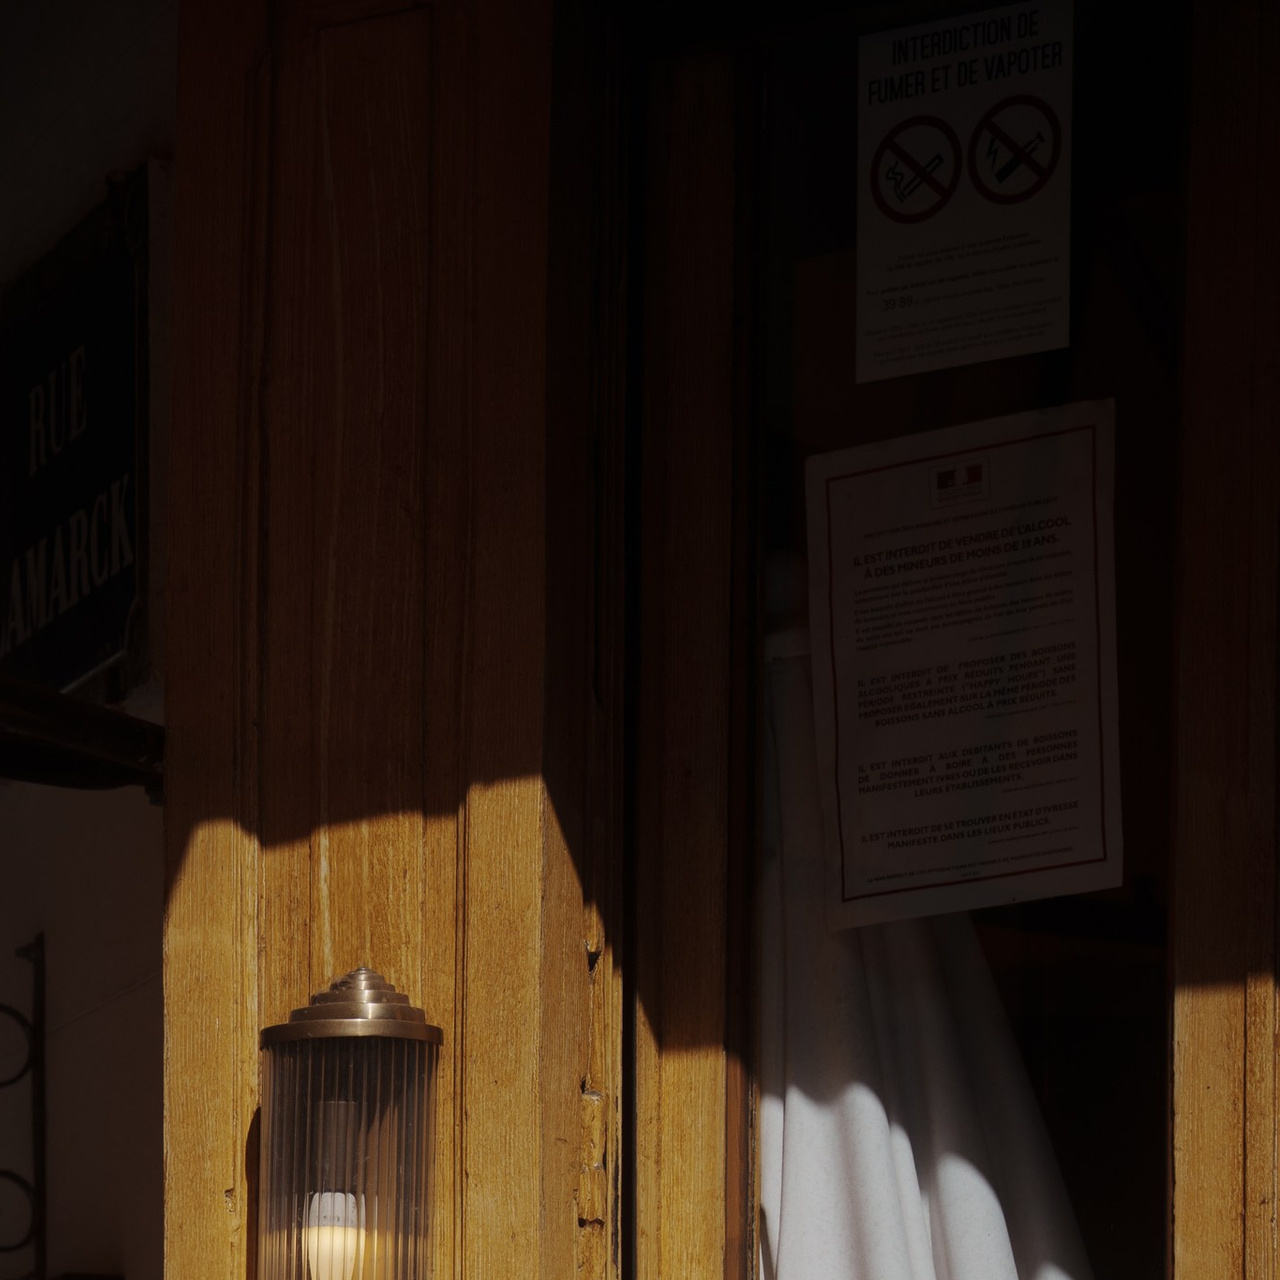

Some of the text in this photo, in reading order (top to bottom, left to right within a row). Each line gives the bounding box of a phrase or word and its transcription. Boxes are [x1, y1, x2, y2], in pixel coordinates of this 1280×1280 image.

[892, 9, 1038, 66] INTERDICTION DE
[868, 40, 1062, 106] FUMER ET DE VAPOTER
[882, 297, 895, 311] 39
[899, 294, 913, 308] 89
[28, 344, 88, 479] RUE
[853, 556, 862, 566] IL
[864, 552, 884, 564] EST
[885, 541, 936, 560] INTERDIT
[938, 538, 952, 550] DE
[955, 529, 998, 547] VENDRE
[1000, 526, 1014, 538] DE
[1017, 515, 1071, 534] L'ALCOOL
[864, 567, 872, 579] À
[874, 564, 895, 577] DES
[897, 554, 947, 573] MINEURS
[949, 551, 963, 563] DE
[966, 544, 1002, 560] MOINS
[1004, 541, 1018, 552] DE
[1022, 538, 1031, 549] 18
[1032, 533, 1059, 547] ANS.
[858, 750, 1078, 795] MANIFESTEMENT IVRES OU DE LES RECEVOIR DANS
[914, 785, 943, 797] LEURS
[861, 834, 867, 843] IL
[869, 832, 884, 842] EST
[886, 824, 930, 839] INTERDIT
[930, 822, 942, 832] DE
[943, 820, 953, 830] SE
[956, 813, 997, 828] TROUVER
[999, 811, 1010, 821] EN
[888, 834, 938, 850] MANIFESTE
[940, 830, 964, 842] DANS
[966, 827, 981, 838] LES
[984, 822, 1010, 834] LIEUX
